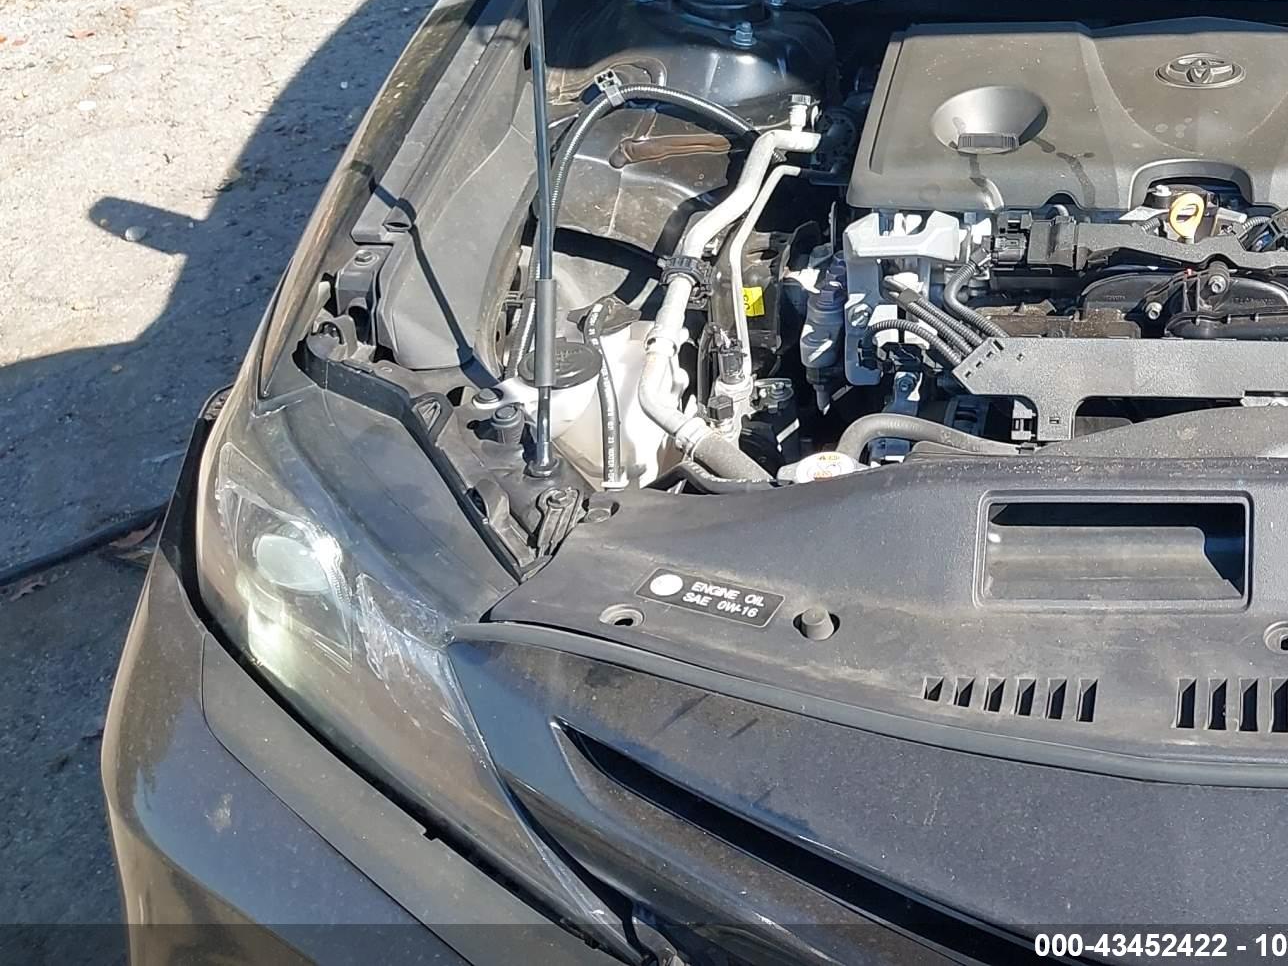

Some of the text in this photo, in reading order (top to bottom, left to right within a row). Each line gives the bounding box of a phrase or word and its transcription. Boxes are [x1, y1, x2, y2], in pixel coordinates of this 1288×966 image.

[682, 592, 759, 618] SAE 0W-16
[691, 581, 765, 607] ENGINE OIL
